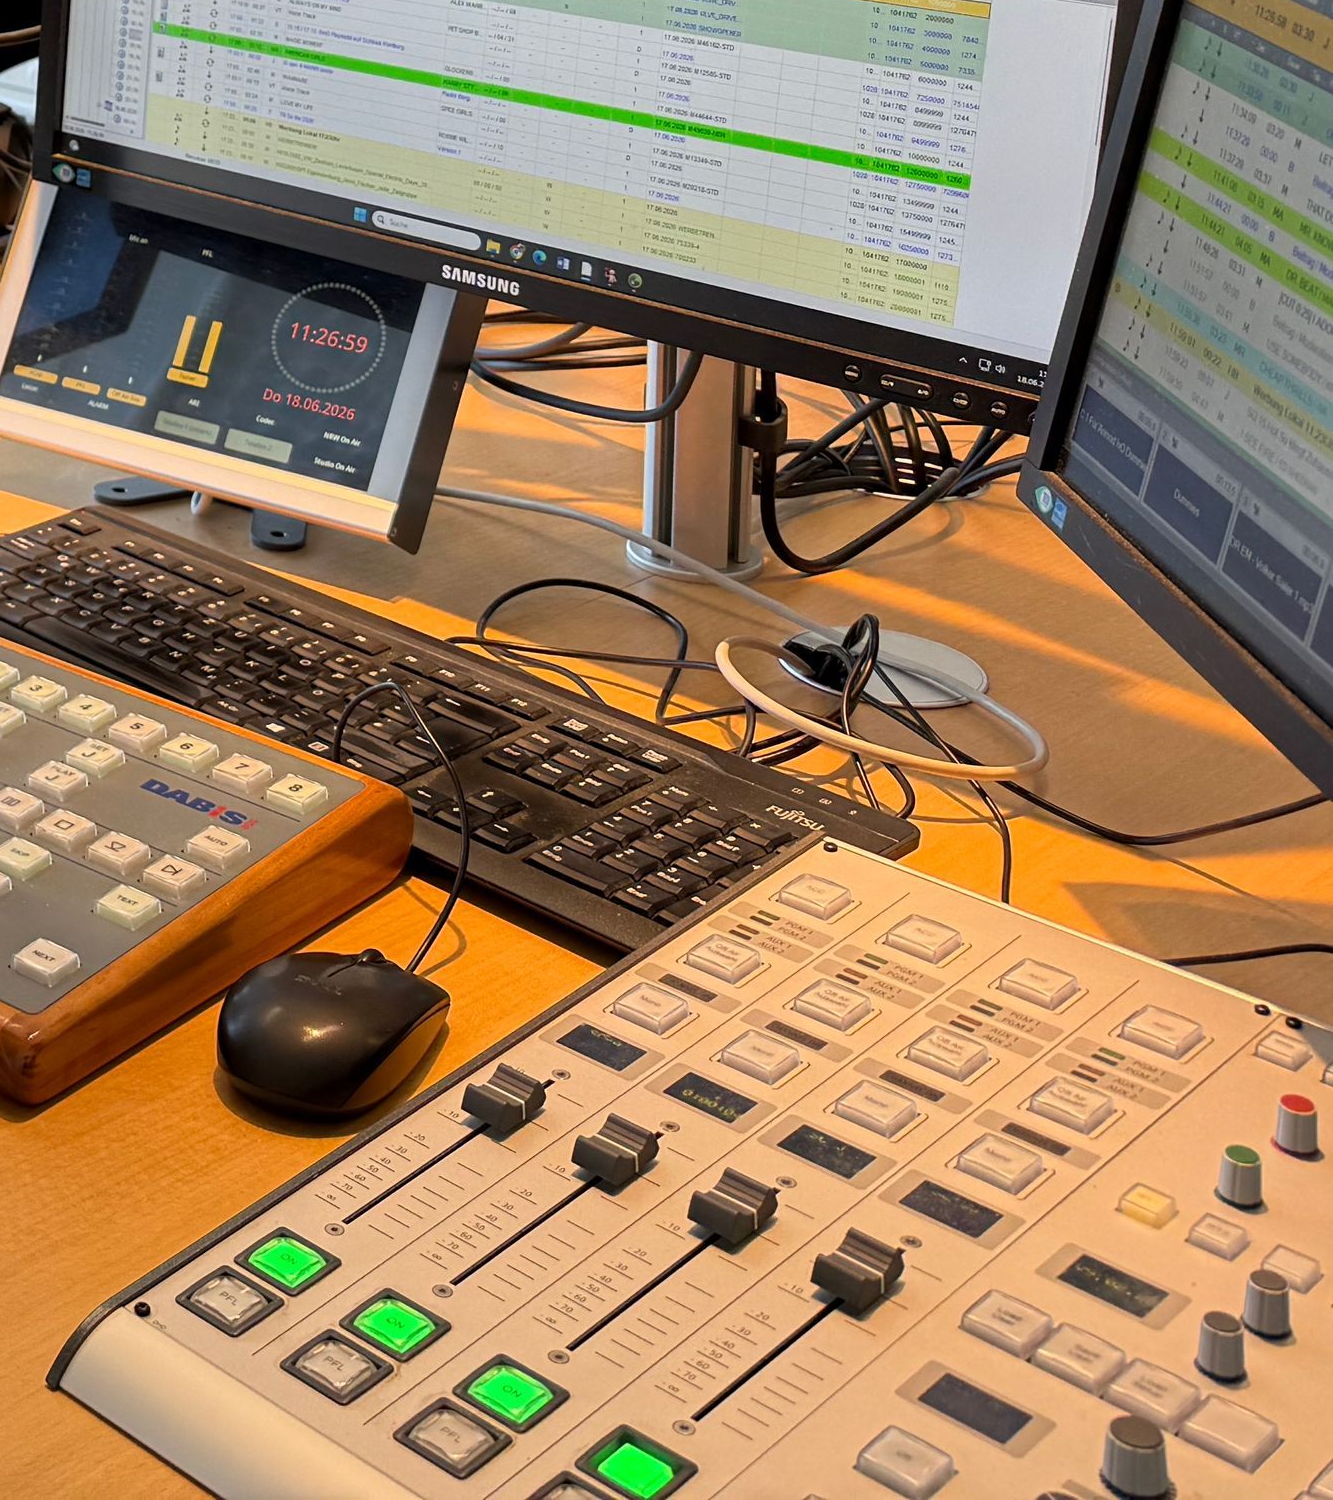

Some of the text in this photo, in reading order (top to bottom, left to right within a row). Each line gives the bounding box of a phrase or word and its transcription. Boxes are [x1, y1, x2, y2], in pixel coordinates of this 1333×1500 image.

[441, 264, 521, 296] SAMSUNG
[291, 321, 369, 353] 11:26:59
[1017, 375, 1045, 388] 18.06.2
[262, 388, 356, 421] Do 18.06.2026
[340, 435, 350, 444] On
[314, 457, 356, 474] Studio On Air
[29, 684, 42, 692] 3
[181, 742, 193, 750] 6
[51, 765, 76, 777] PLAY
[289, 784, 303, 792] 8
[766, 804, 825, 832] FUJITSU
[204, 835, 228, 847] AUTO
[117, 894, 139, 905] TEXT
[32, 949, 56, 962] NEXT
[279, 1253, 297, 1265] ON
[219, 1291, 238, 1306] PFL
[386, 1317, 406, 1330] ON
[323, 1355, 344, 1372] PFL
[502, 1385, 523, 1398] ON
[440, 1427, 462, 1444] PFL
